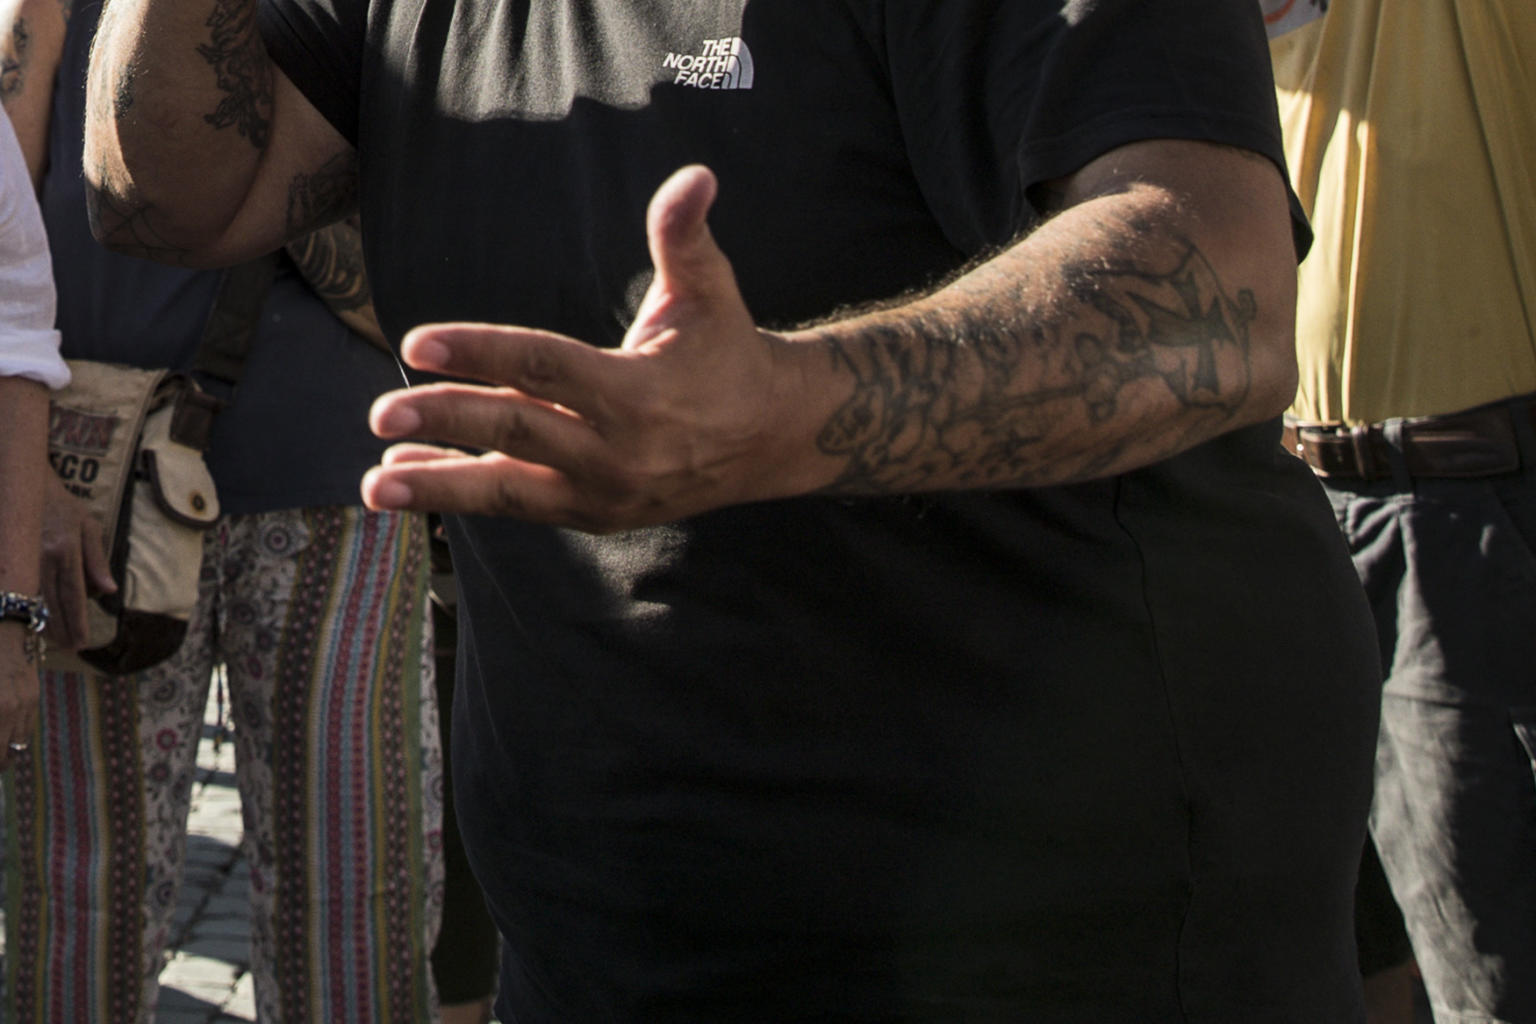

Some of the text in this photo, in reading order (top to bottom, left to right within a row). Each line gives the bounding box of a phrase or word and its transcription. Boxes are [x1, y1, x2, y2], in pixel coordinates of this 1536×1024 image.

[703, 38, 732, 56] THE
[663, 52, 728, 73] NORTH
[674, 71, 724, 89] FACE
